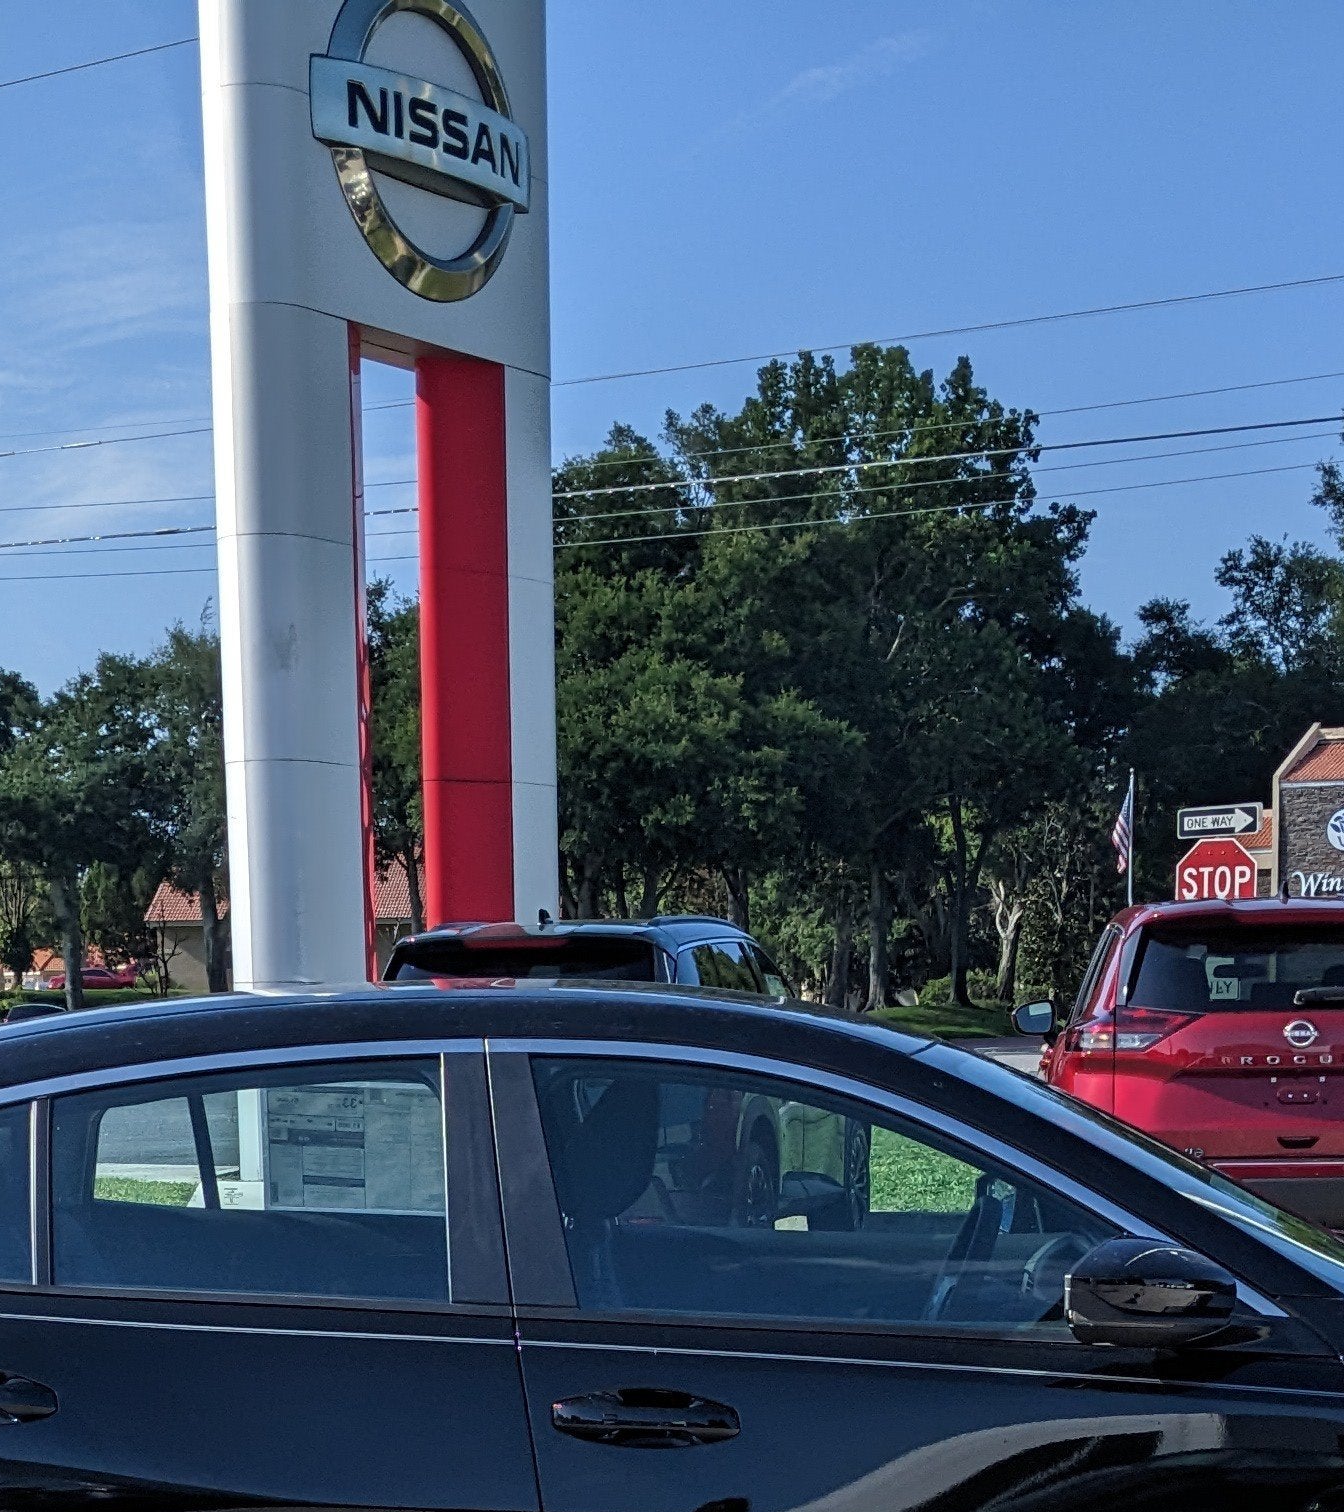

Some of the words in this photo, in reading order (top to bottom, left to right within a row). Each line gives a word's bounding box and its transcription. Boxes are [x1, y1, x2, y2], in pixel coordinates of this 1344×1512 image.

[346, 79, 521, 187] NISSAN
[1186, 817, 1208, 829] ONE
[1211, 815, 1234, 828] WAY
[1181, 865, 1251, 900] STOP
